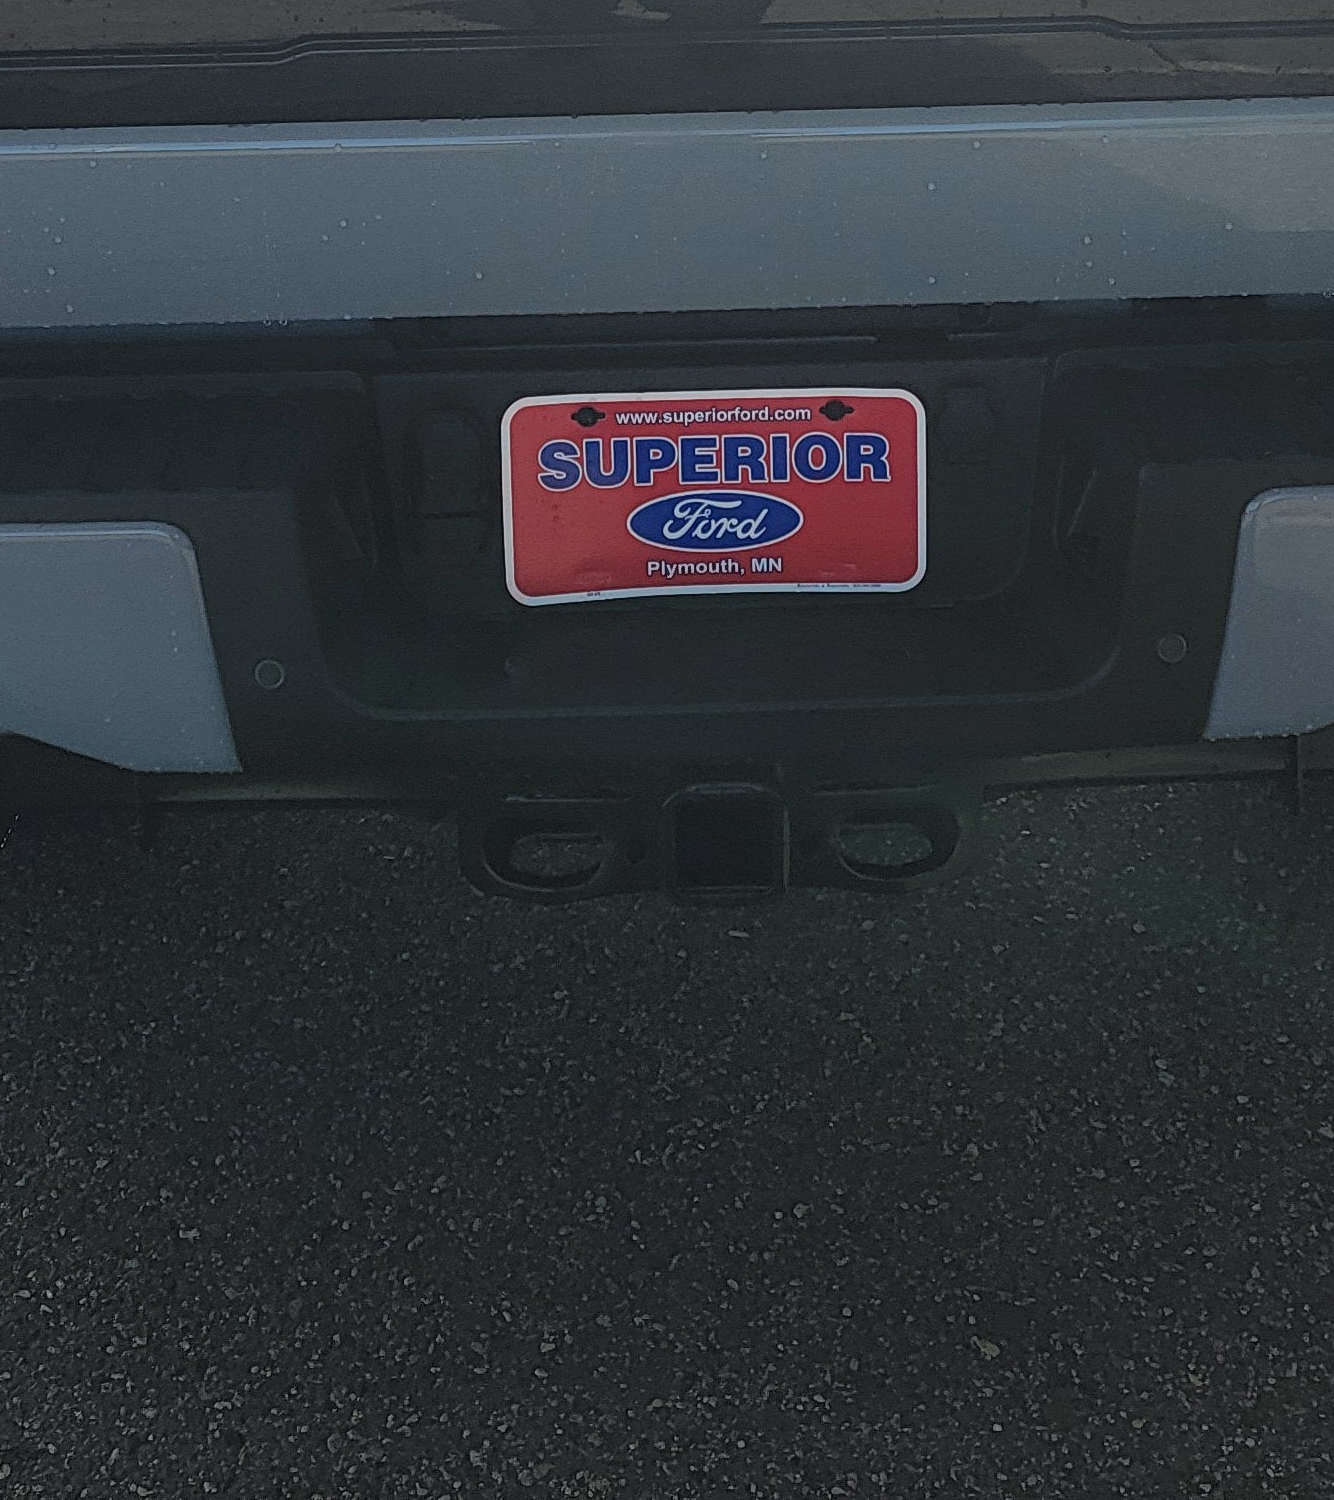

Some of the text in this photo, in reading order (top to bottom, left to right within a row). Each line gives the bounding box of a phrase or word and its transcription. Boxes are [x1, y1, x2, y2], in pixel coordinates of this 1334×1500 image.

[615, 406, 812, 426] www.superiorford.com
[538, 432, 891, 491] SUPERIOR
[662, 499, 769, 541] Ford
[647, 557, 782, 578] Plymouth, MN
